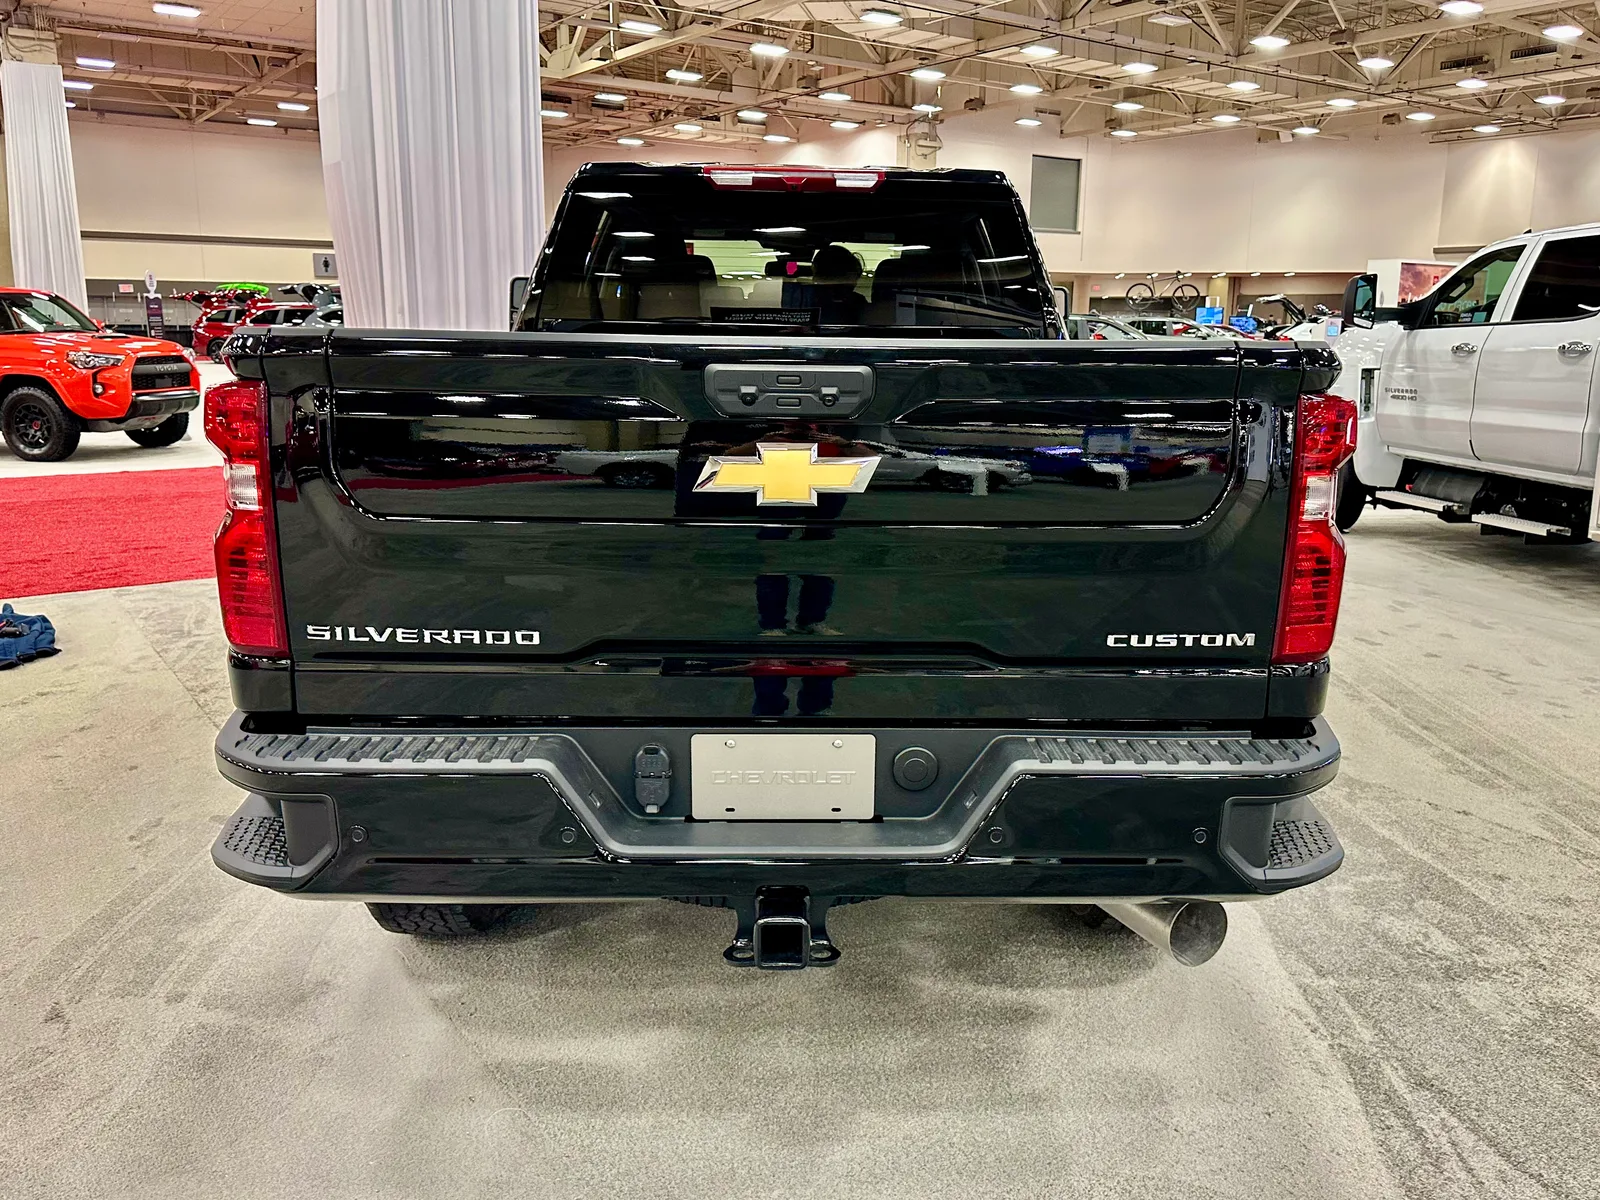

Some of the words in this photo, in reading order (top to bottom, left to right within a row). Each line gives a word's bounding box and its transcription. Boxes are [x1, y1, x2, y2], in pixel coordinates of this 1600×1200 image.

[1384, 387, 1418, 395] SILVERADO
[306, 625, 541, 645] SILVERADO
[1106, 633, 1256, 647] CUSTOM
[711, 770, 856, 785] CHEVROLET
